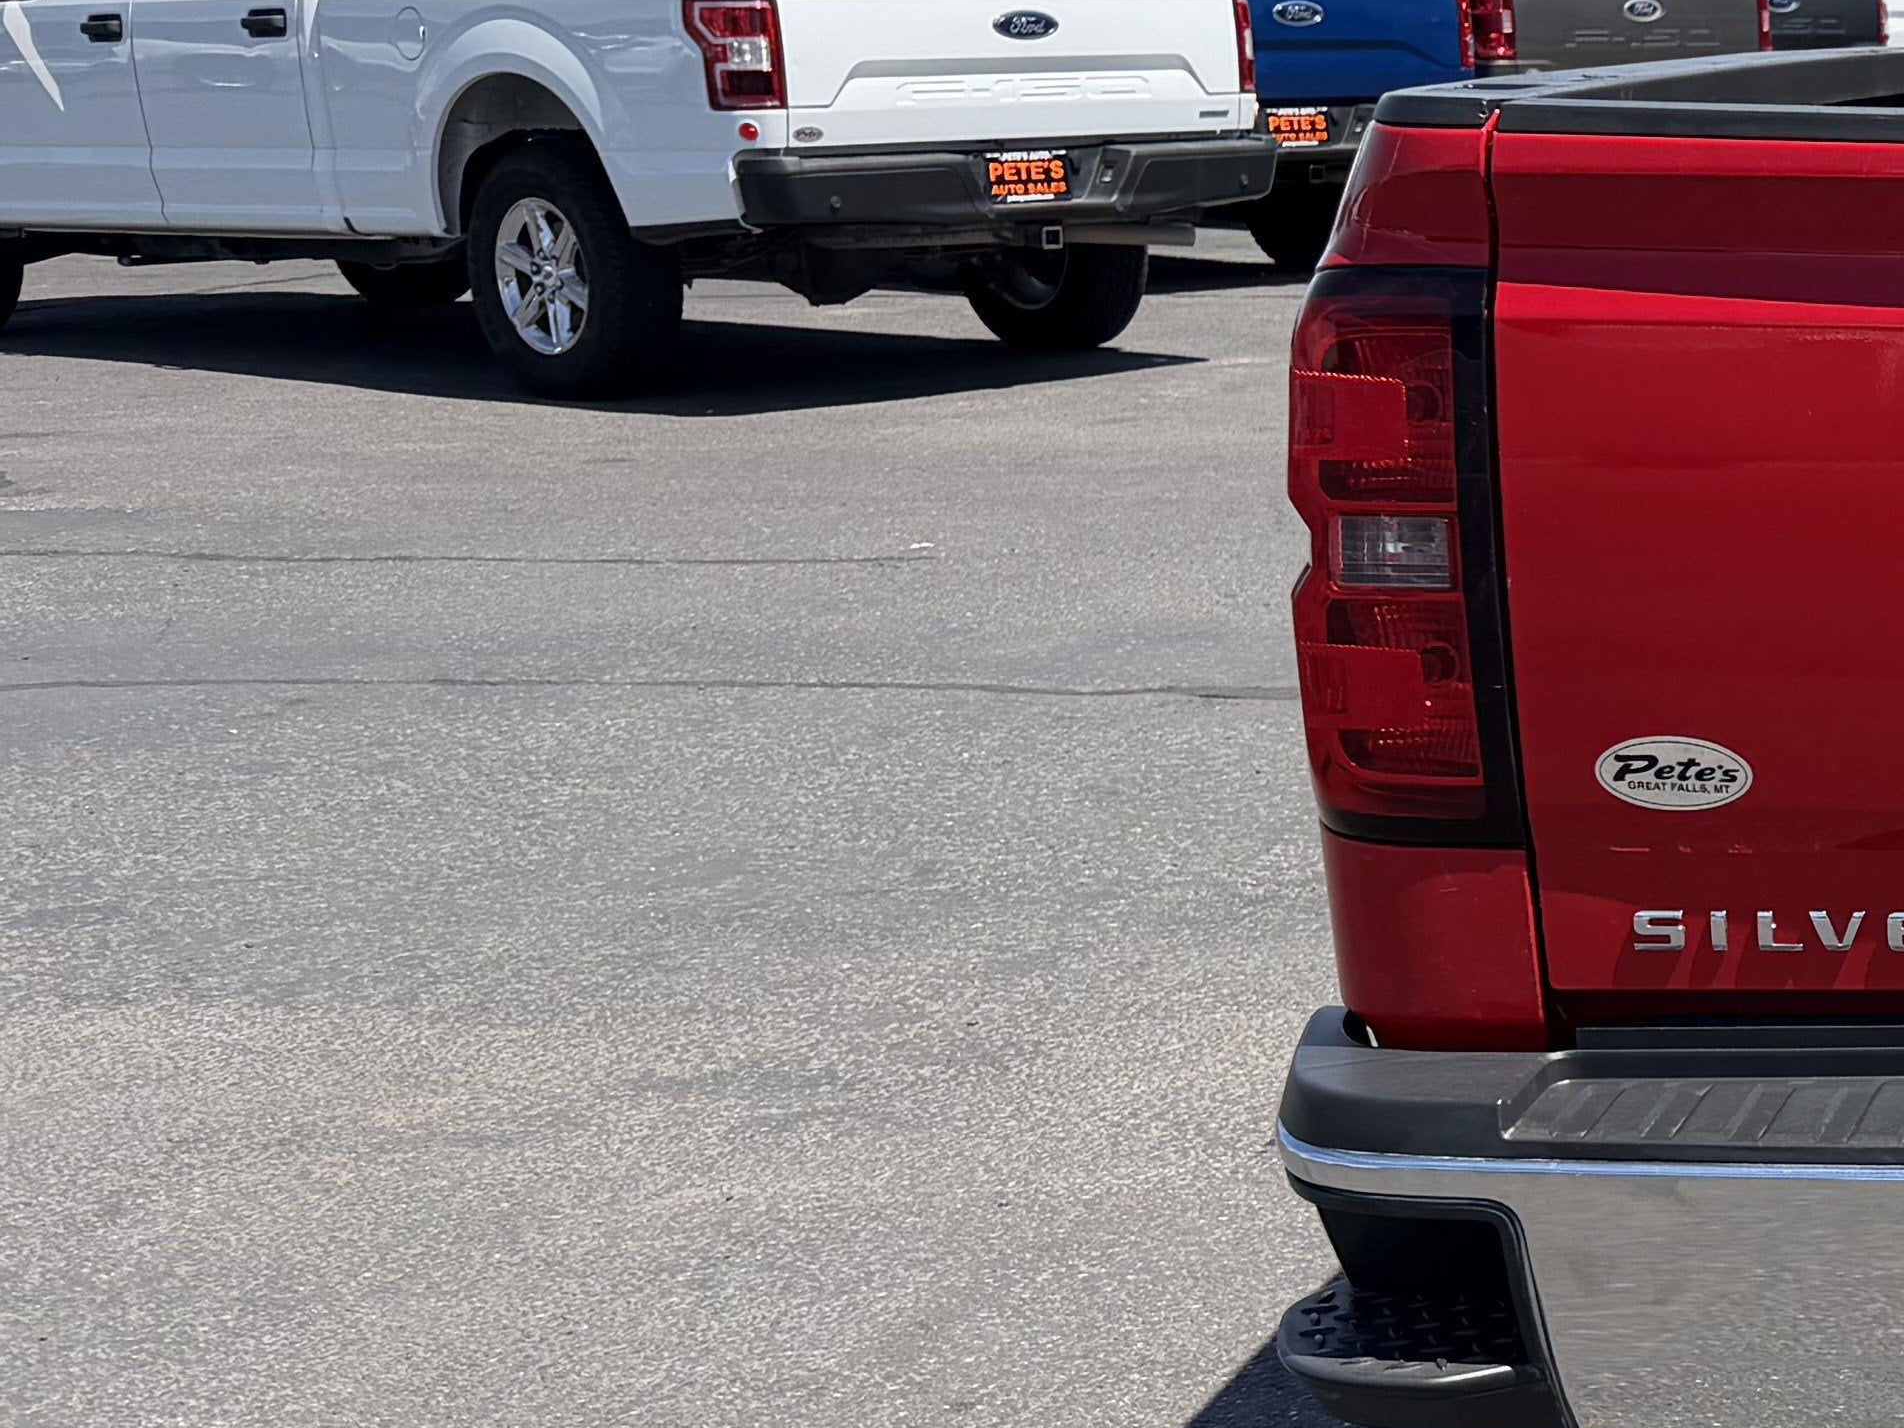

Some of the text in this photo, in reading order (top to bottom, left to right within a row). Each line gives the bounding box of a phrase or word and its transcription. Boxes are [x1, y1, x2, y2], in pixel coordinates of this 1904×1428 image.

[1009, 16, 1046, 34] Ford
[988, 160, 1065, 182] PETE'S
[1612, 754, 1740, 783] Pete's
[1628, 780, 1667, 793] GREAT
[1714, 784, 1731, 795] MT
